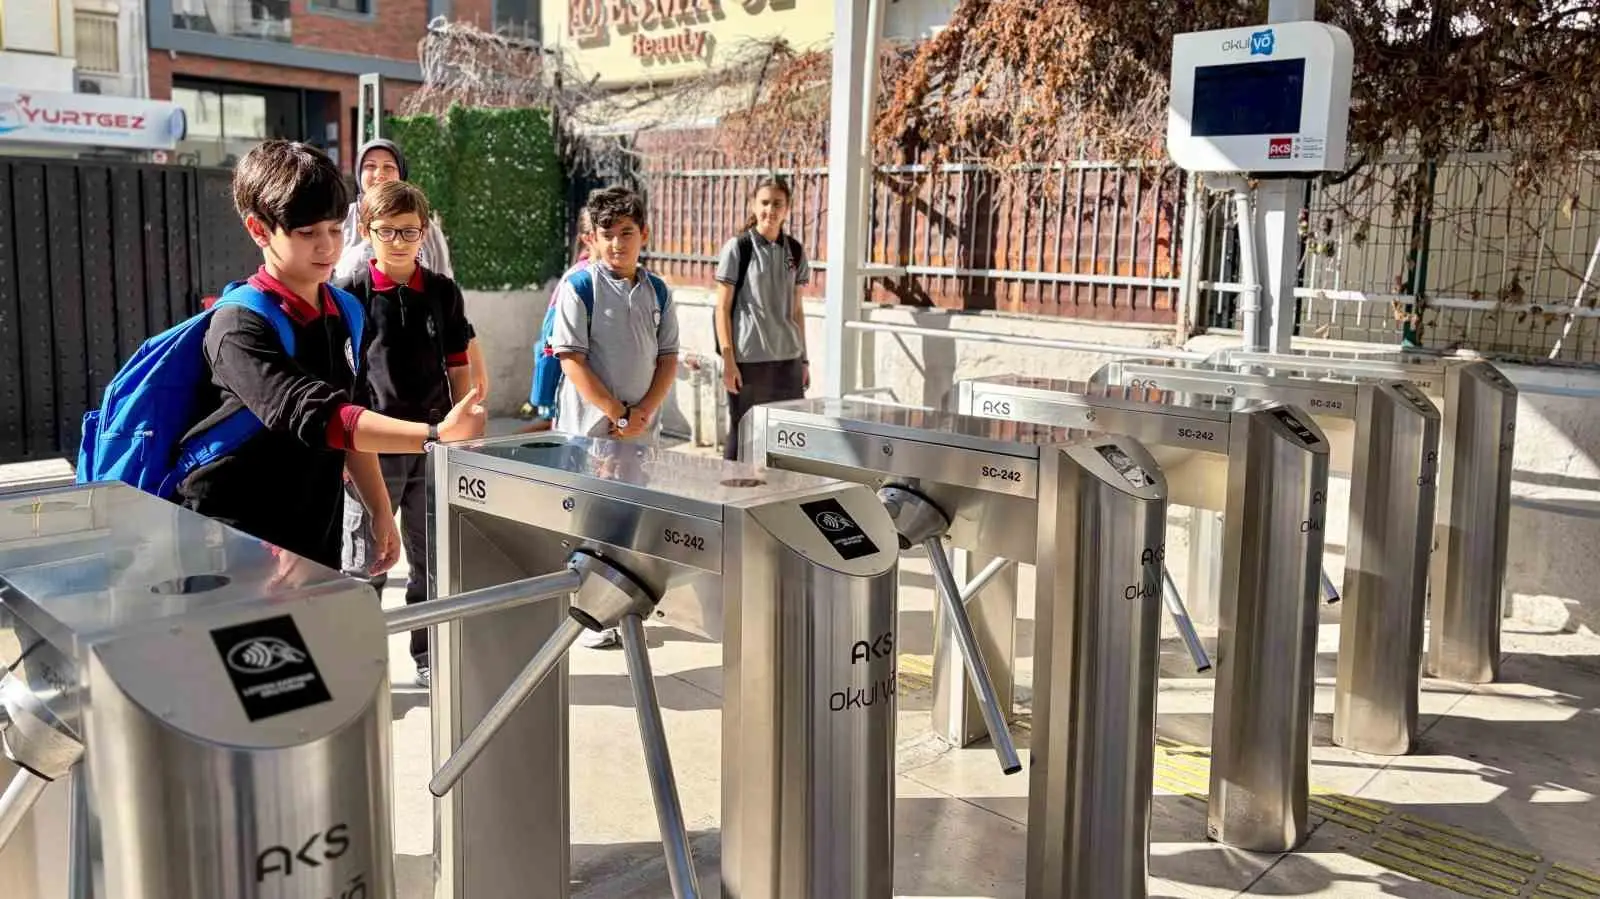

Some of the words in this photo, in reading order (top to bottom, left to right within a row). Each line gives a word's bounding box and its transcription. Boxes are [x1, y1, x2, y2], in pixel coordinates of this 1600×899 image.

[632, 29, 706, 57] Beauty
[1222, 36, 1250, 51] okul
[22, 108, 146, 130] YURTGEZ
[1269, 144, 1290, 154] AKS
[983, 400, 1011, 415] AKS
[777, 429, 806, 447] AKS
[1177, 427, 1214, 441] SC-242
[982, 466, 1021, 482] SC-242
[458, 475, 486, 498] AKS
[664, 528, 705, 551] SC-242
[851, 632, 893, 665] AKS
[829, 680, 878, 712] okul
[256, 823, 350, 882] AKS
